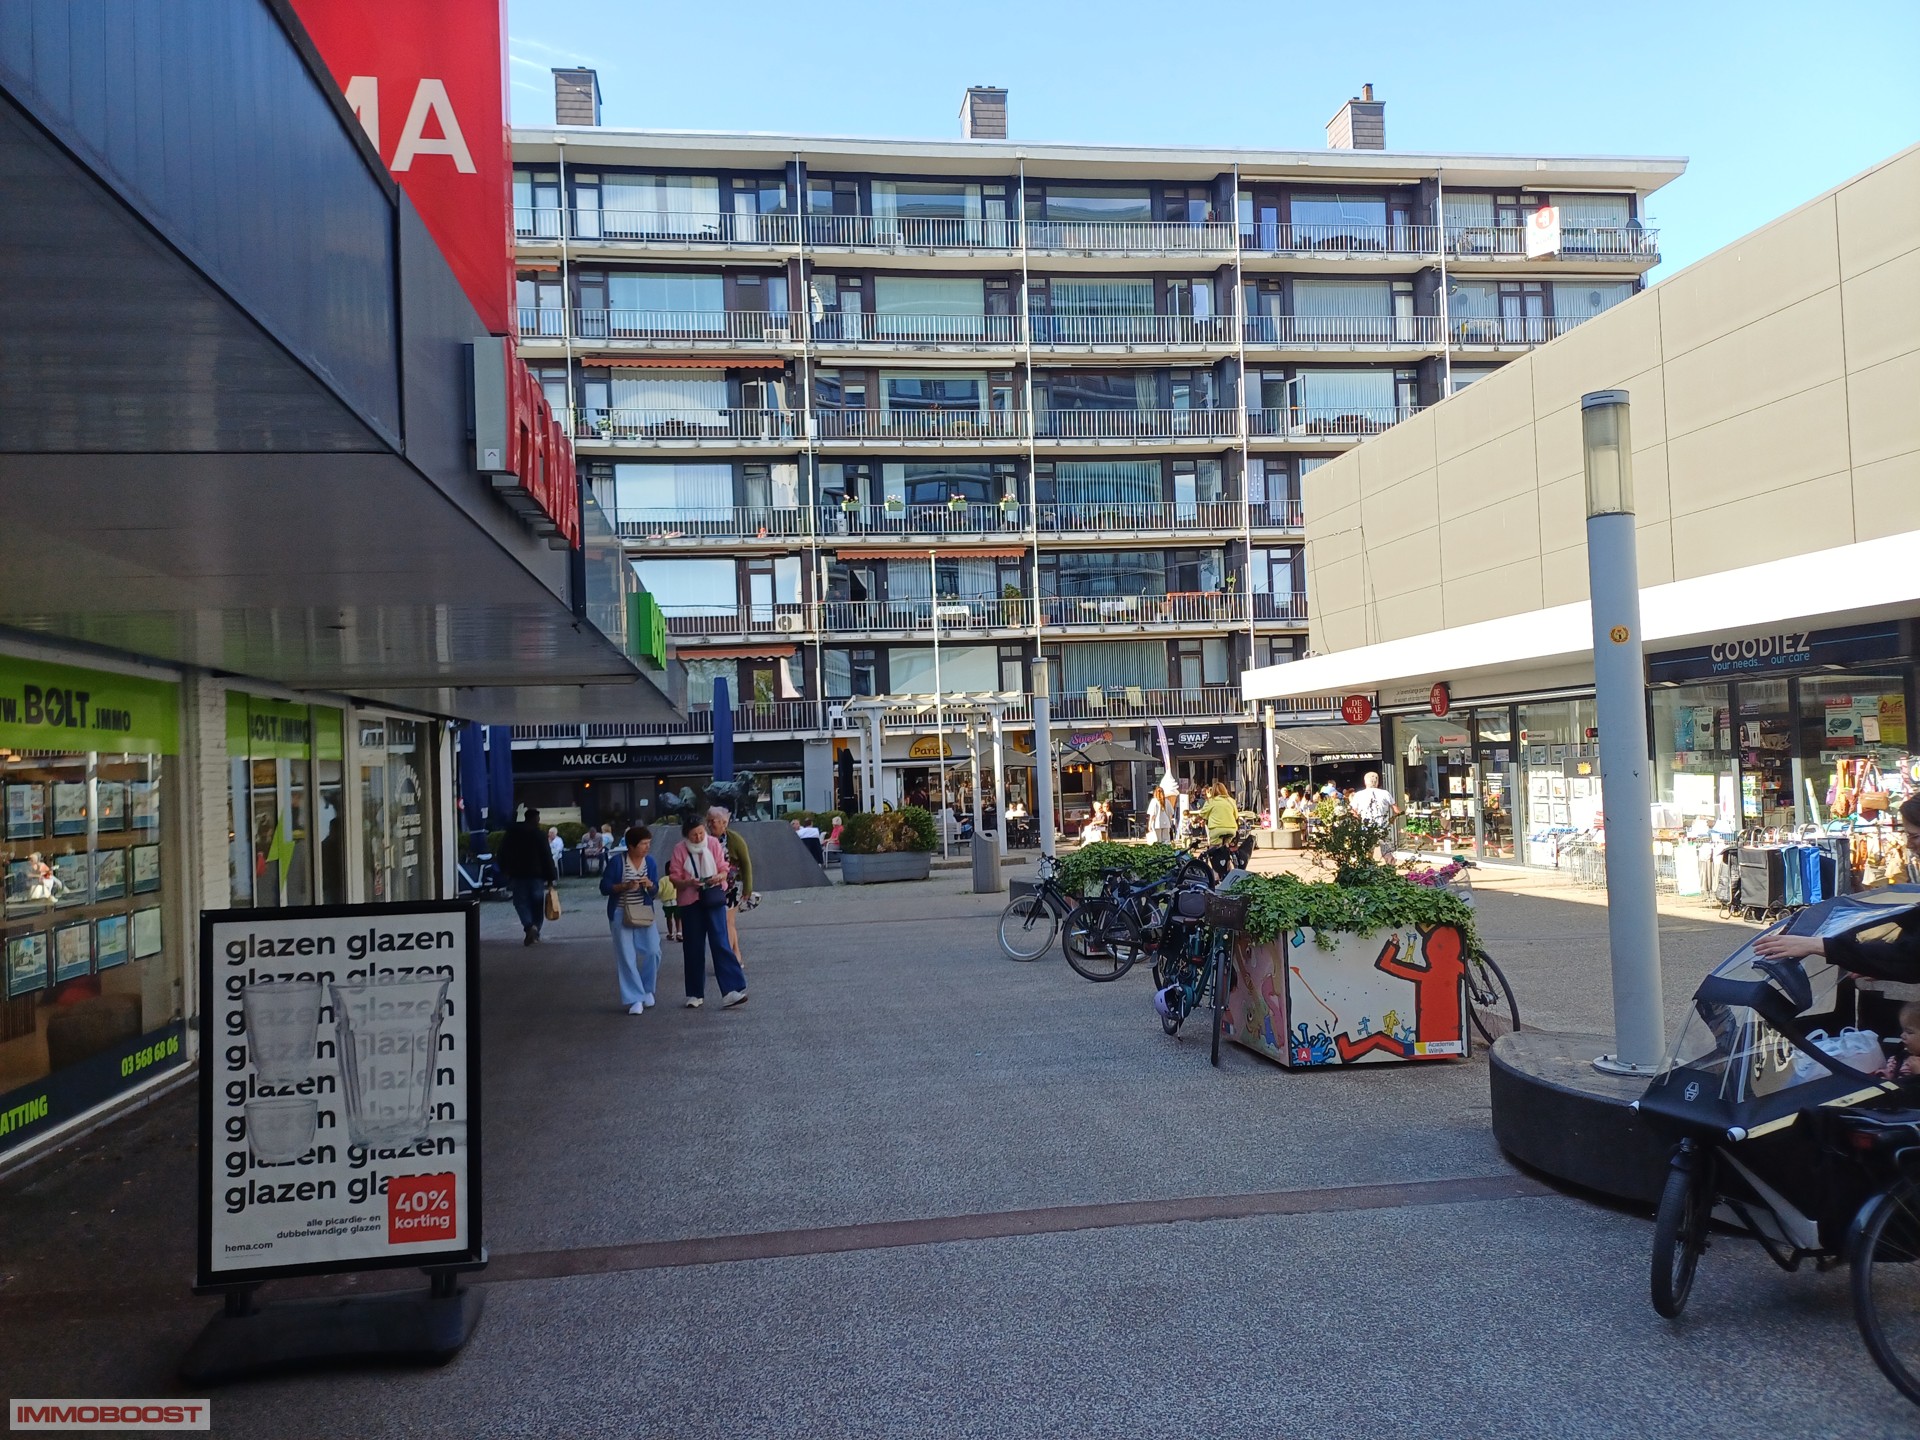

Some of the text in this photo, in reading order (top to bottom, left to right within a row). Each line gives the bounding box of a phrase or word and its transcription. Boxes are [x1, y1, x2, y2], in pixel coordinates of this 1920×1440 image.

[1711, 632, 1810, 662] GOODIEZ
[1712, 662, 1731, 673] your
[1771, 655, 1787, 664] our
[1789, 652, 1810, 662] care
[1346, 706, 1363, 714] WAE
[1351, 699, 1363, 707] DE
[1353, 713, 1364, 721] LE
[1180, 733, 1208, 742] SWAF
[562, 753, 700, 765] MARCEAU UITVAARTZORG
[225, 928, 454, 966] glazen glazen
[121, 1035, 179, 1077] 03 568 68 06
[224, 1179, 336, 1213] glazen
[395, 1189, 450, 1213] 40%
[306, 1214, 381, 1228] alle picardie- en
[394, 1212, 451, 1230] korting
[276, 1223, 382, 1240] dubbelwandige glazen
[225, 1242, 273, 1253] hema.com
